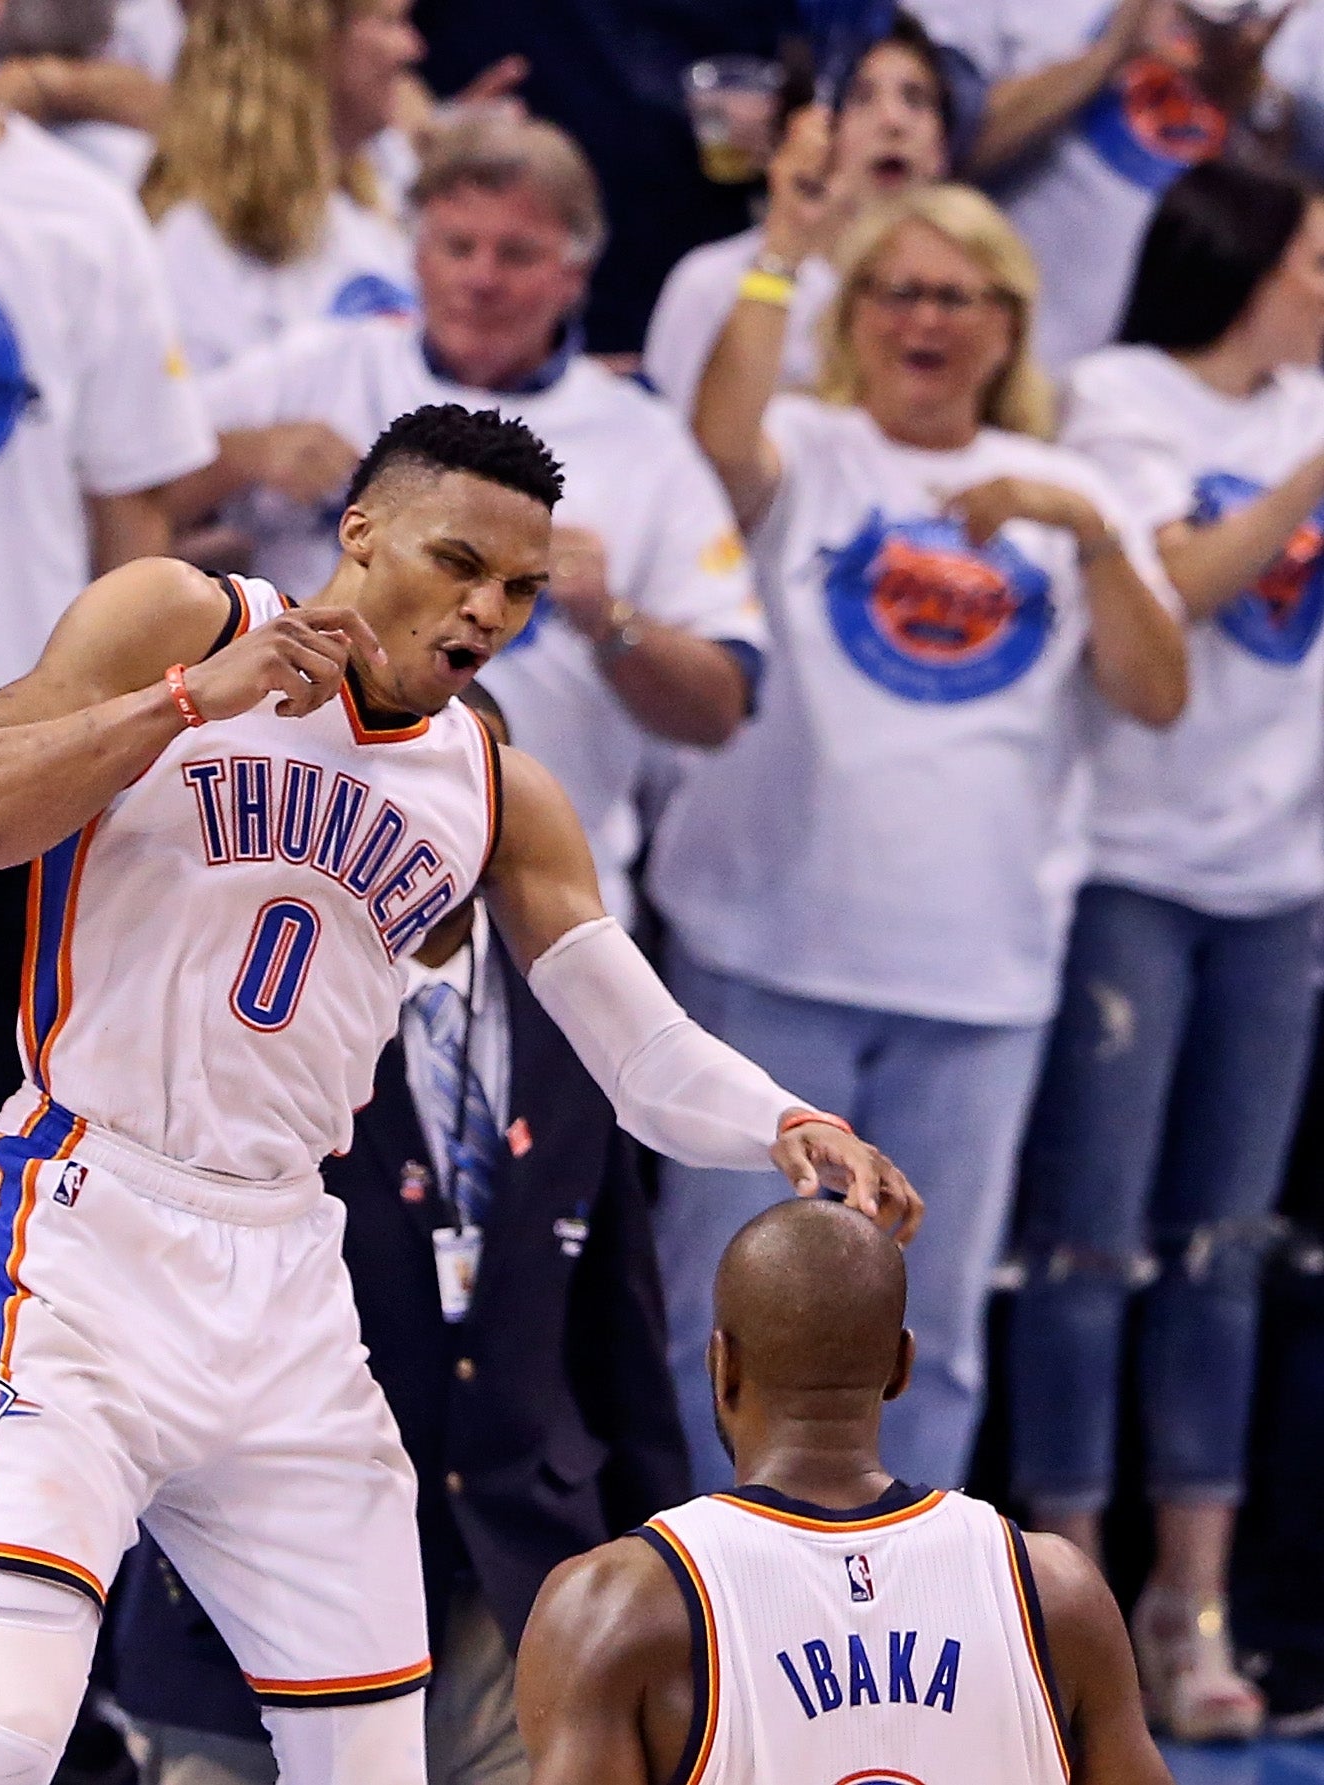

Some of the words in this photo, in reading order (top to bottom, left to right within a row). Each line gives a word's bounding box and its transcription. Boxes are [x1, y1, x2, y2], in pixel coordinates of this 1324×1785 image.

[181, 757, 457, 965] THUNDER
[229, 896, 321, 1033] 0
[776, 1631, 961, 1720] IBAKA
